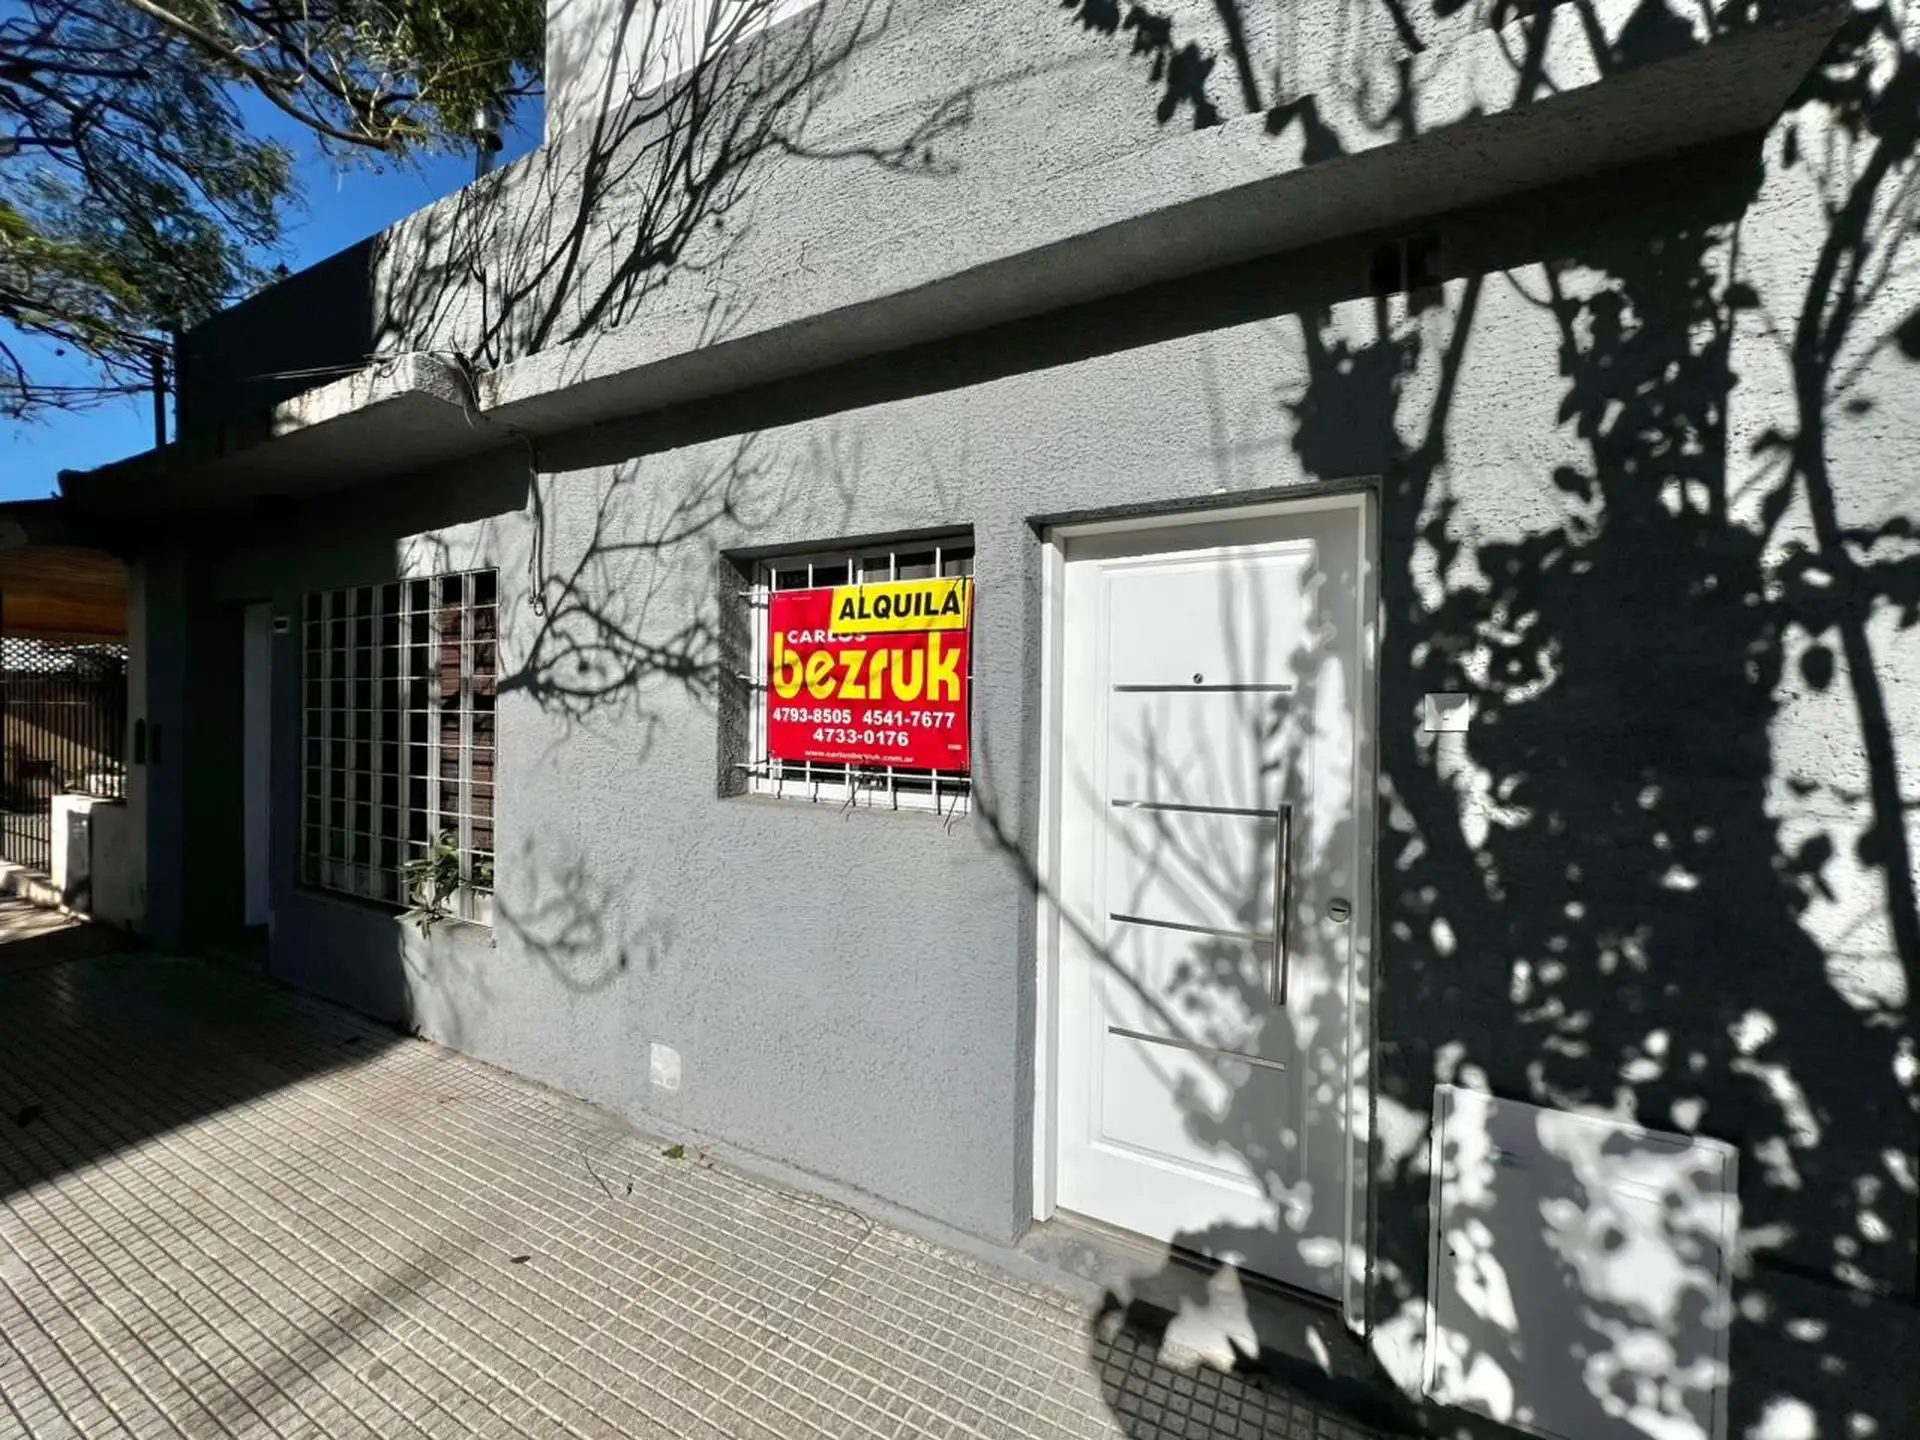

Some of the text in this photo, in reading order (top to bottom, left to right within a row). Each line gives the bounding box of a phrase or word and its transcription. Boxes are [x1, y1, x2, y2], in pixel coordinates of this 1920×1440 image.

[839, 590, 960, 620] ALQUILA
[773, 632, 961, 702] bezruk
[772, 707, 955, 728] 4793-8505 4541-7677
[813, 728, 909, 746] 4733-0176
